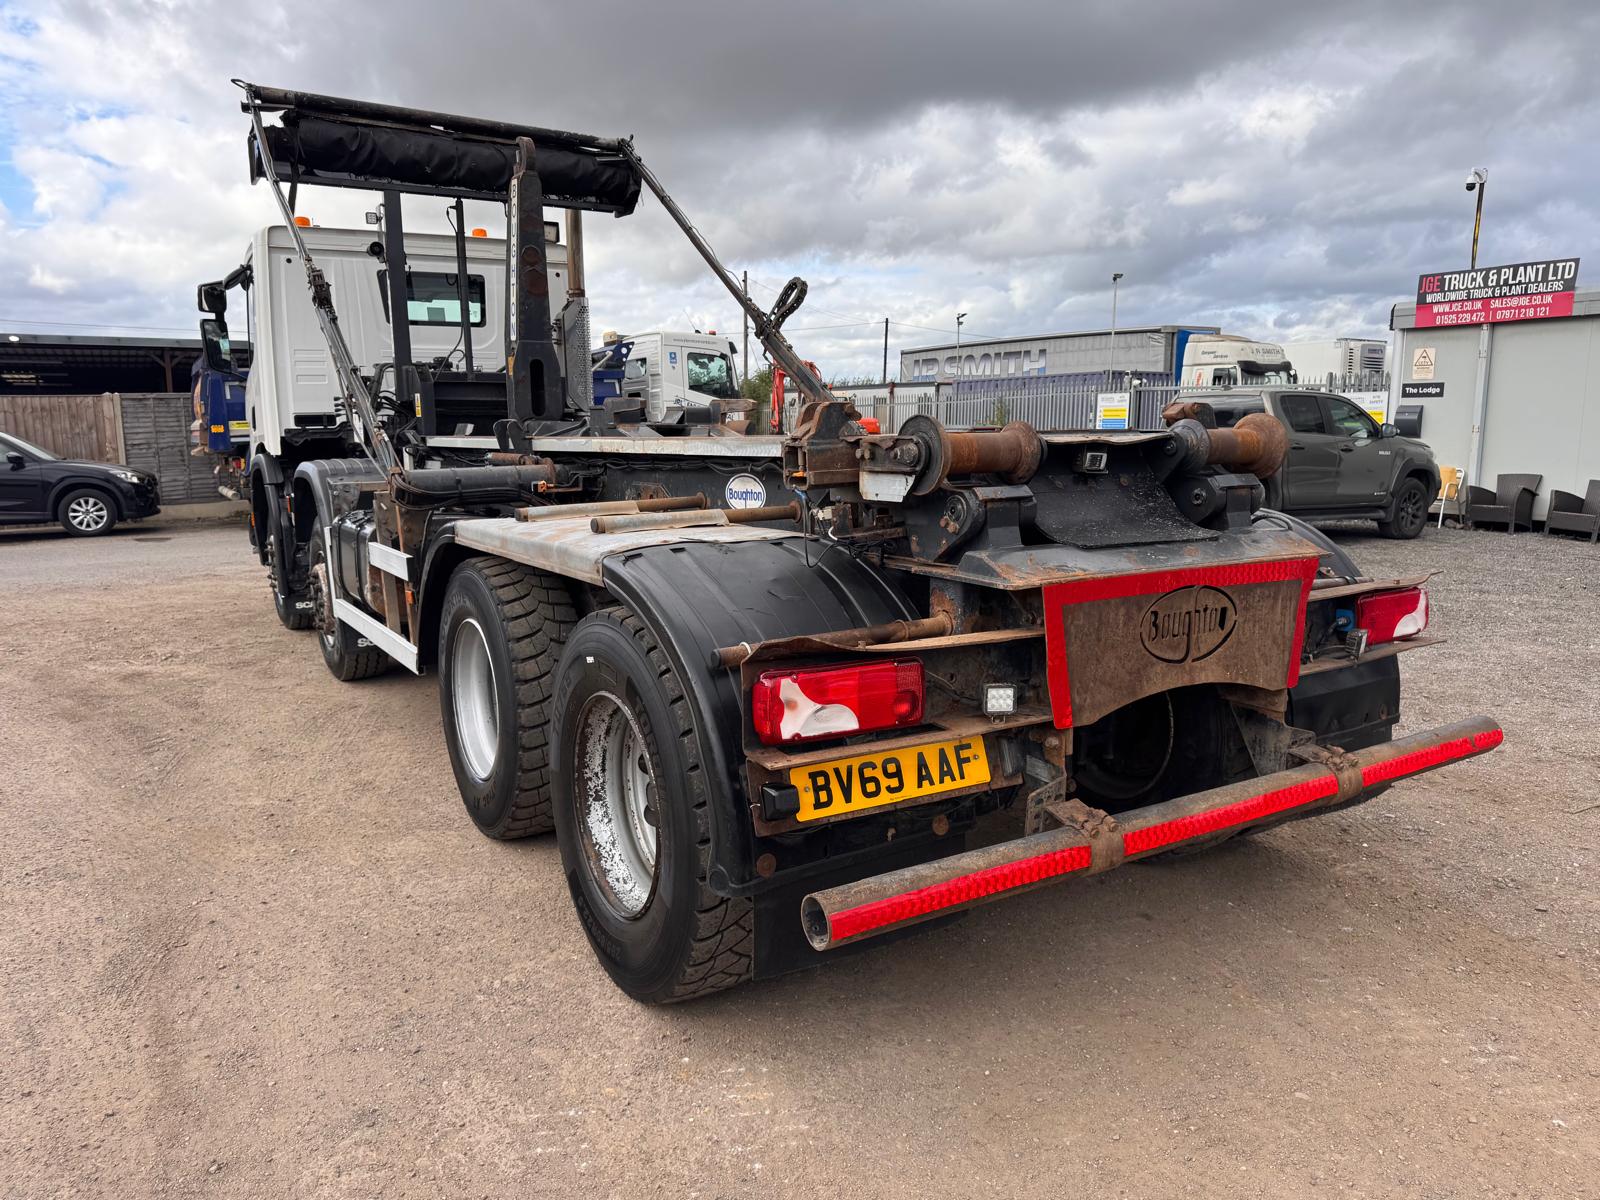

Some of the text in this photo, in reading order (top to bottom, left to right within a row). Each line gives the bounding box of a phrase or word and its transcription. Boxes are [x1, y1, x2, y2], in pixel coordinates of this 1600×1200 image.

[1420, 261, 1576, 293] JGE TRUCK & PLANT LTD
[1426, 281, 1564, 303] WORLDWIDE TRUCK & PLANT DEALERS
[1490, 294, 1553, 308] SALES@JGE.CO.UK
[1436, 307, 1550, 325] 01525 229 472 07971 218 121
[944, 349, 1047, 379] SMITH
[728, 487, 764, 505] Boughton
[808, 742, 973, 811] BV69 AAF
